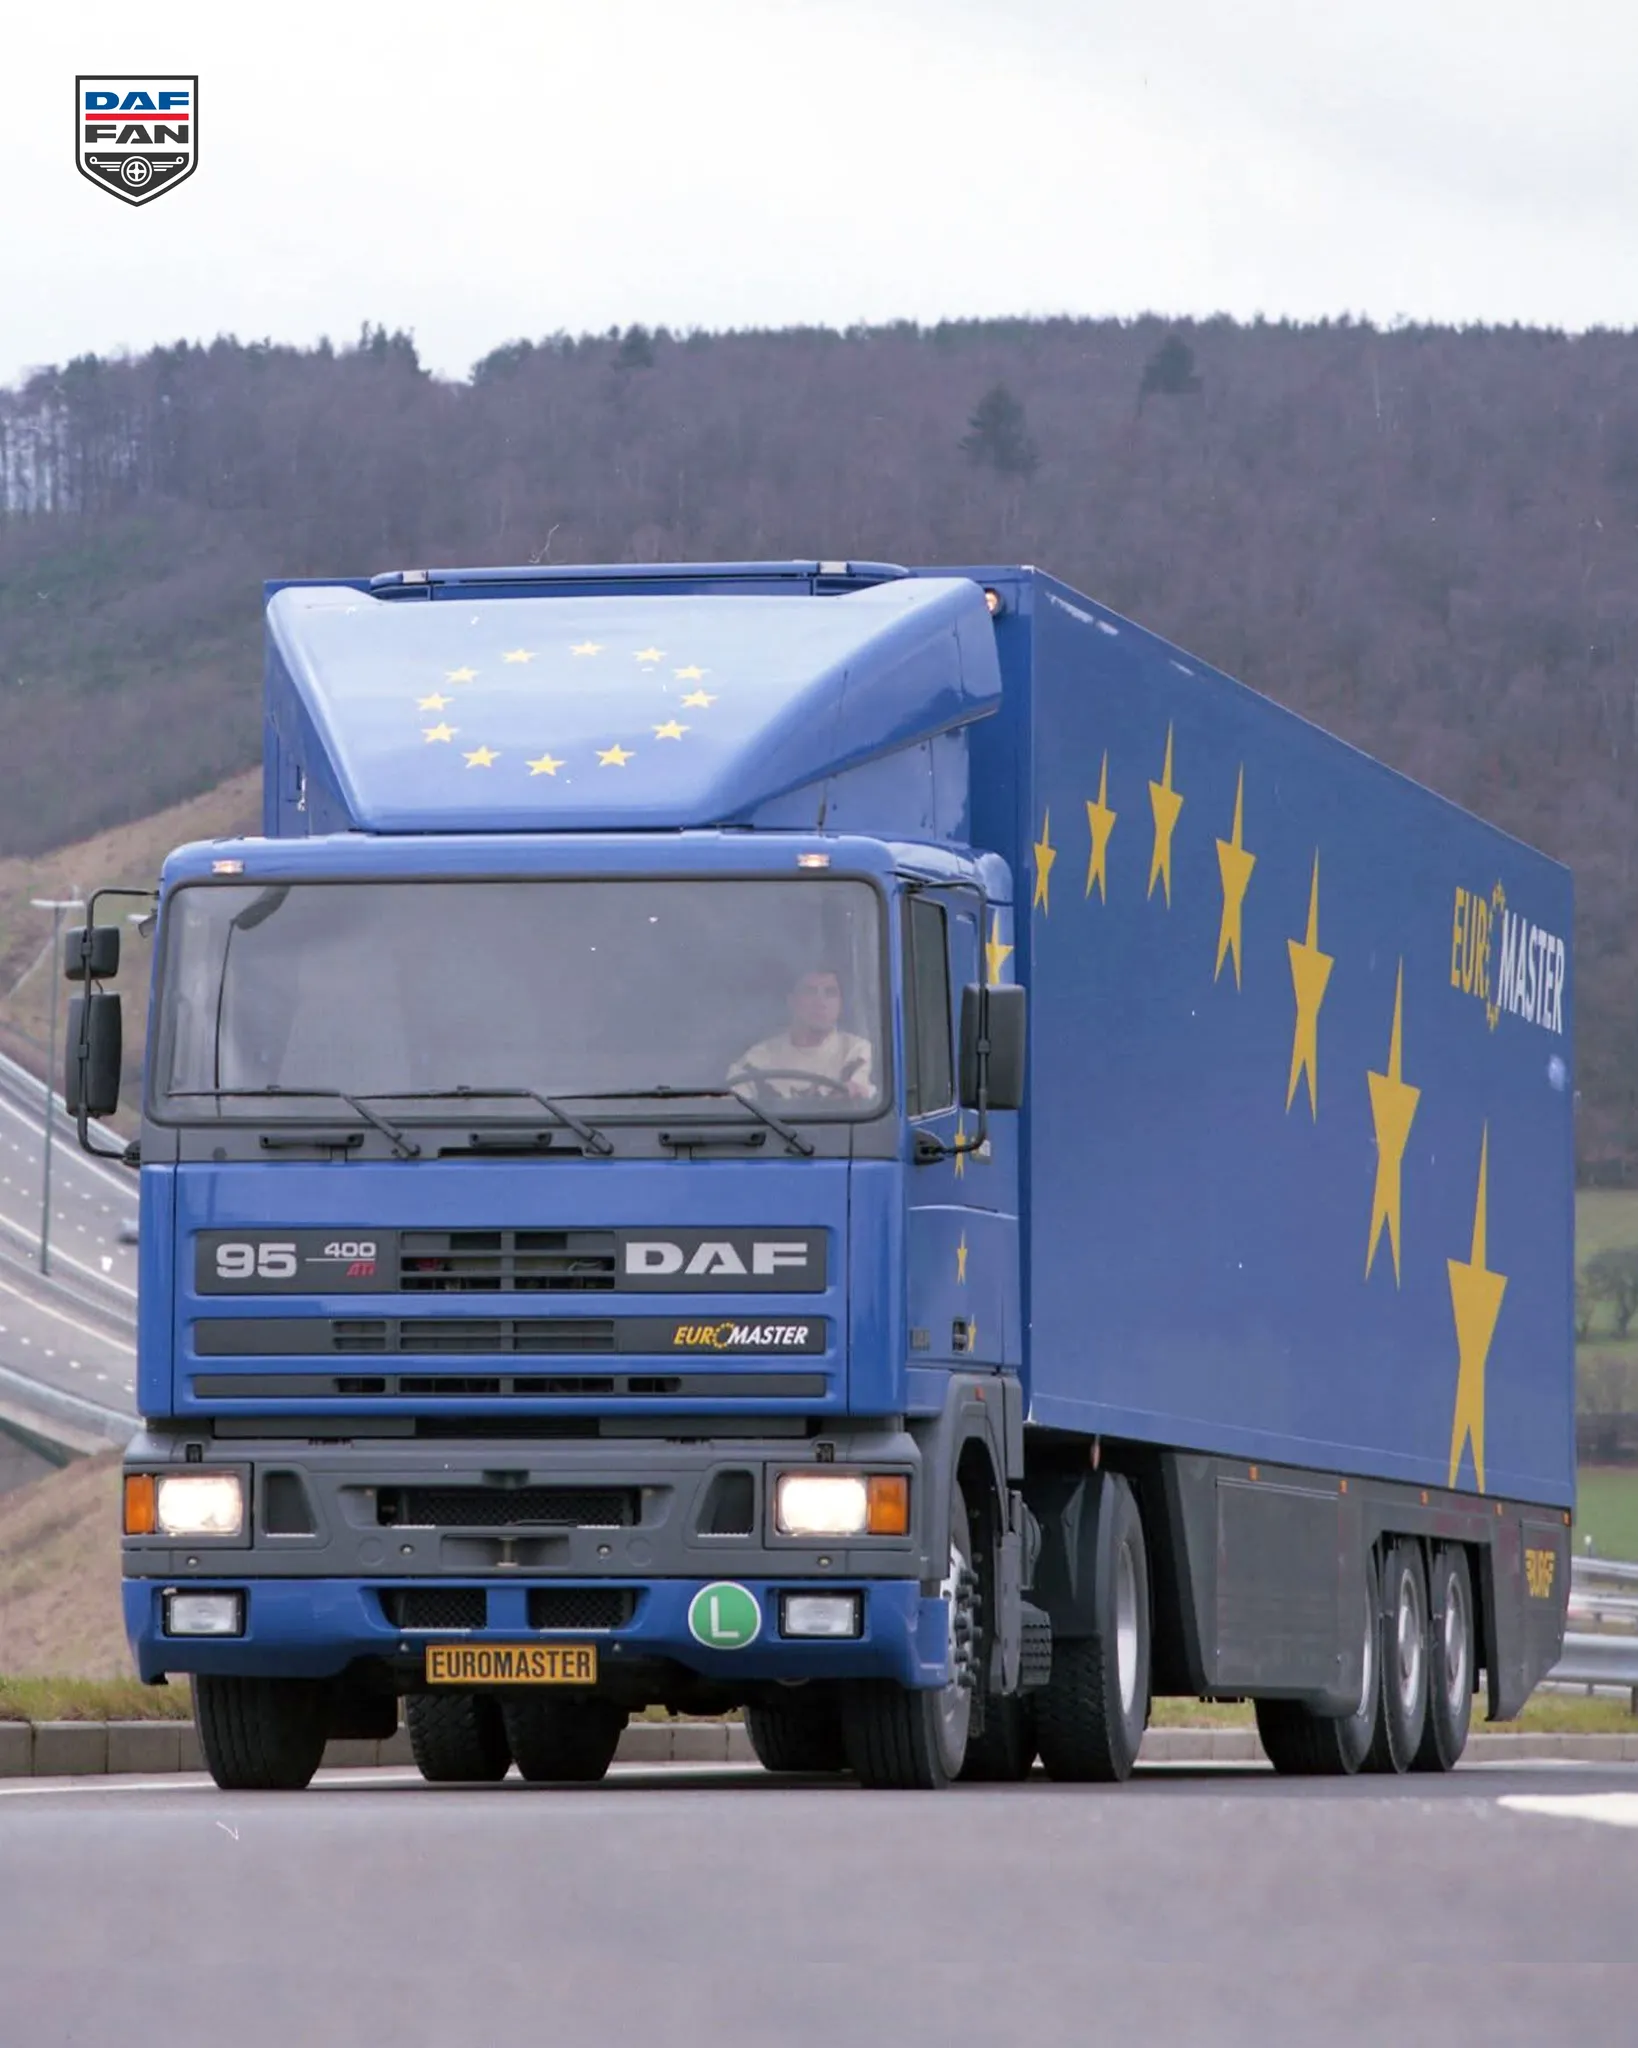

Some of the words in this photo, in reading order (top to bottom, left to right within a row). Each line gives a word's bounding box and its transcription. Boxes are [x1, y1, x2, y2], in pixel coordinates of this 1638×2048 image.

[216, 1243, 297, 1278] 95
[324, 1242, 376, 1257] 400
[625, 1242, 808, 1274] DAF
[673, 1322, 809, 1348] EUROMASTER
[710, 1596, 740, 1638] L
[431, 1651, 591, 1679] EUROMASTER
